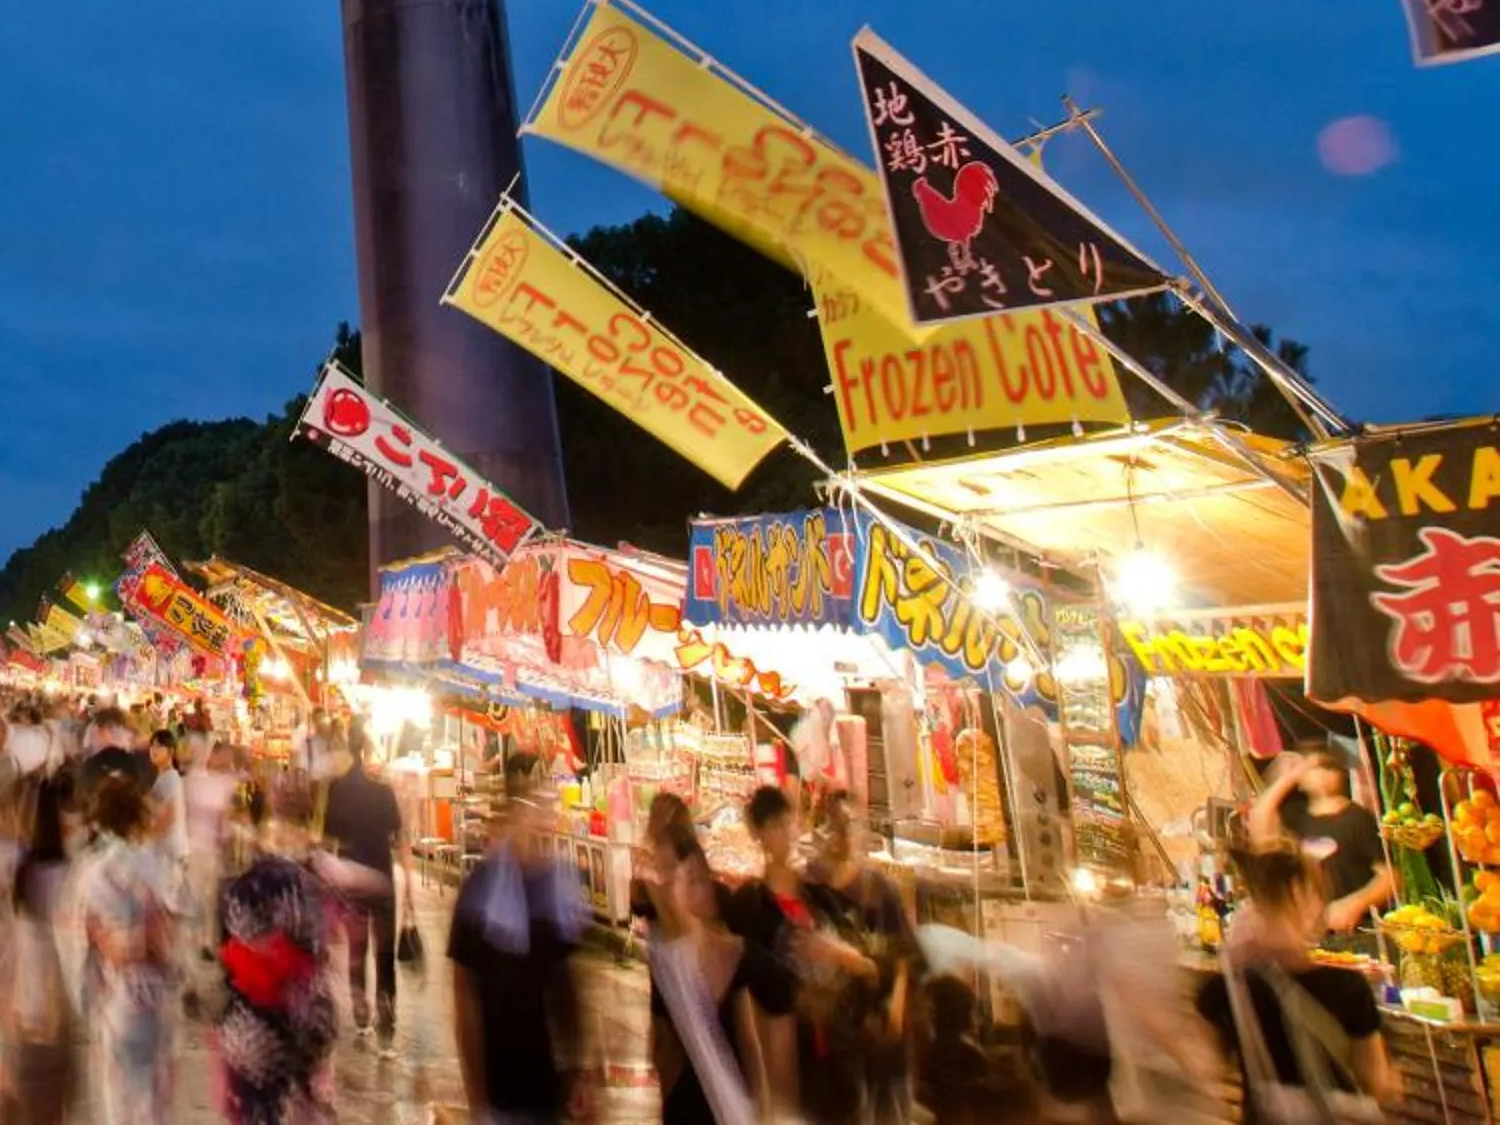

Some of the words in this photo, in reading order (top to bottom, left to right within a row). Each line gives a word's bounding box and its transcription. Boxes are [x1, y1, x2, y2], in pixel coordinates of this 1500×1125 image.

[873, 81, 928, 173] 地鶏
[927, 121, 971, 169] 赤
[925, 242, 1103, 310] やきとり
[833, 336, 983, 432] Frozen
[984, 309, 1109, 404] Cofe
[713, 512, 832, 620] ドネルサンド
[1119, 620, 1281, 672] Frozen
